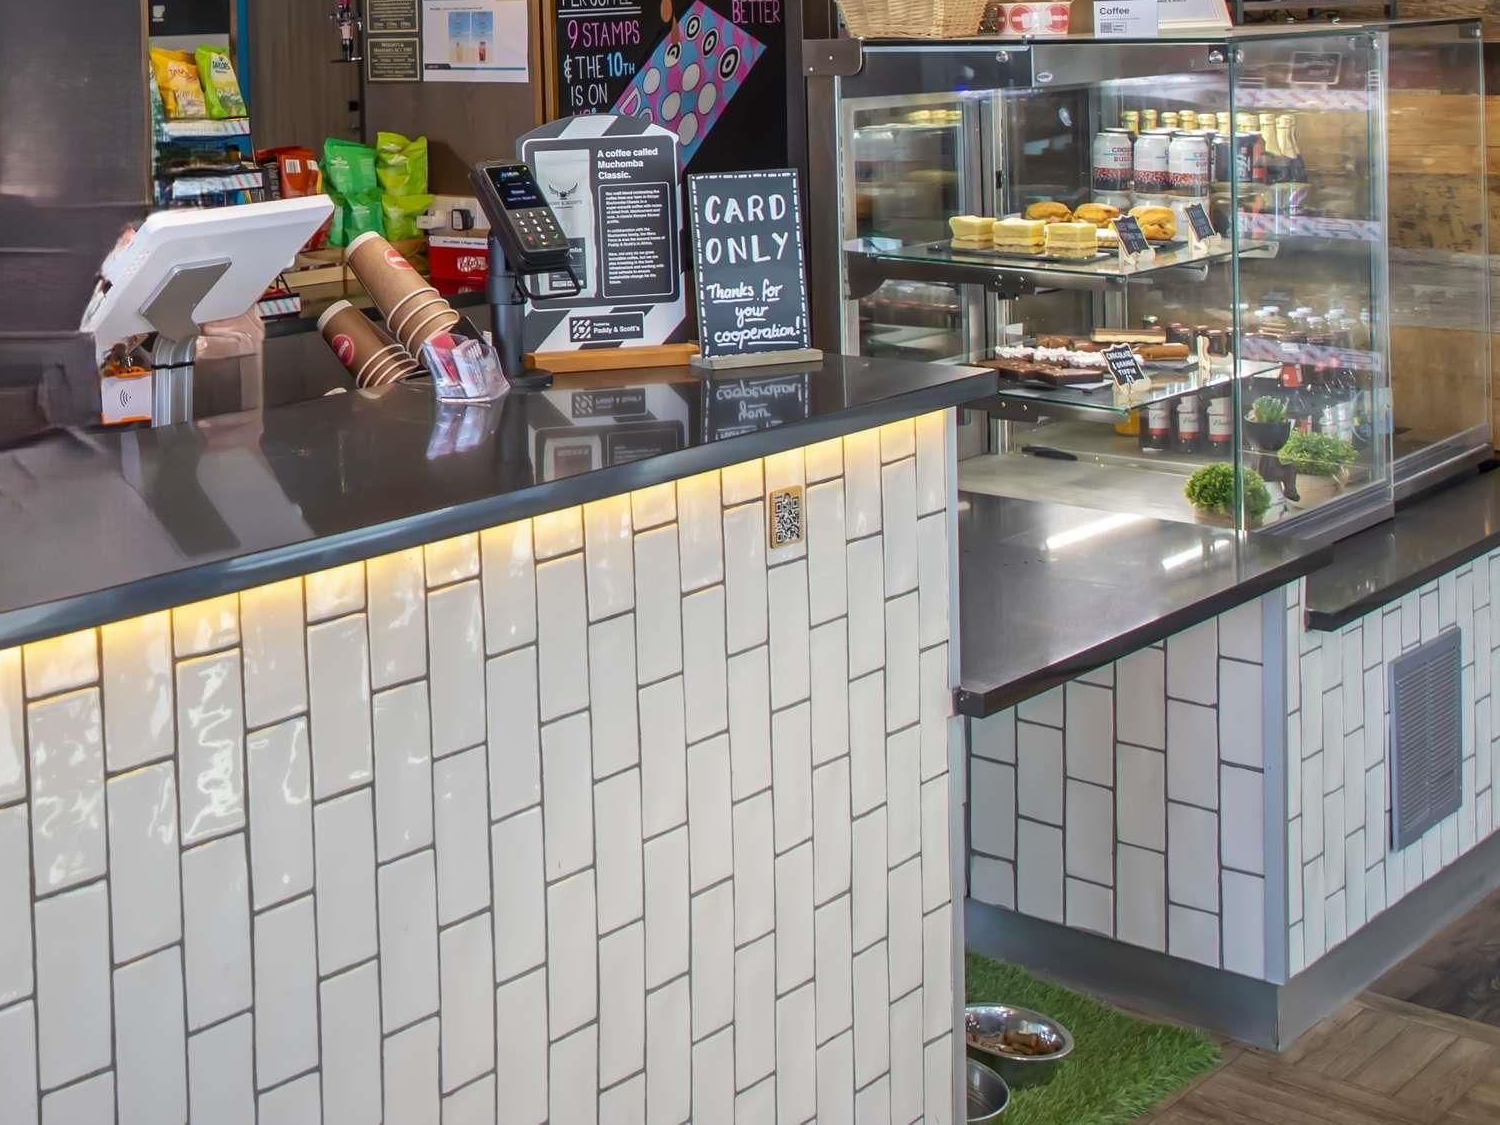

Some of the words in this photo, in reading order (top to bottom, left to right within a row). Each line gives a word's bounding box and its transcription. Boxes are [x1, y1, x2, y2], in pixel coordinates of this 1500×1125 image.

[732, 0, 780, 23] BETTER
[1100, 7, 1130, 15] Coffee
[568, 19, 578, 49] 9
[583, 19, 640, 48] STAMPS
[564, 55, 572, 83] &
[575, 55, 604, 79] THE
[570, 85, 584, 107] IS
[588, 83, 608, 105] ON
[606, 149, 632, 157] coffee
[633, 148, 658, 156] called
[598, 159, 644, 169] Muchomba
[598, 171, 632, 179] Classic.
[705, 194, 786, 225] CARD
[706, 232, 788, 265] ONLY
[707, 282, 754, 301] Thanks
[762, 279, 783, 301] for
[736, 305, 768, 327] your
[594, 327, 612, 335] Paddy
[714, 316, 800, 349] cooperation!
